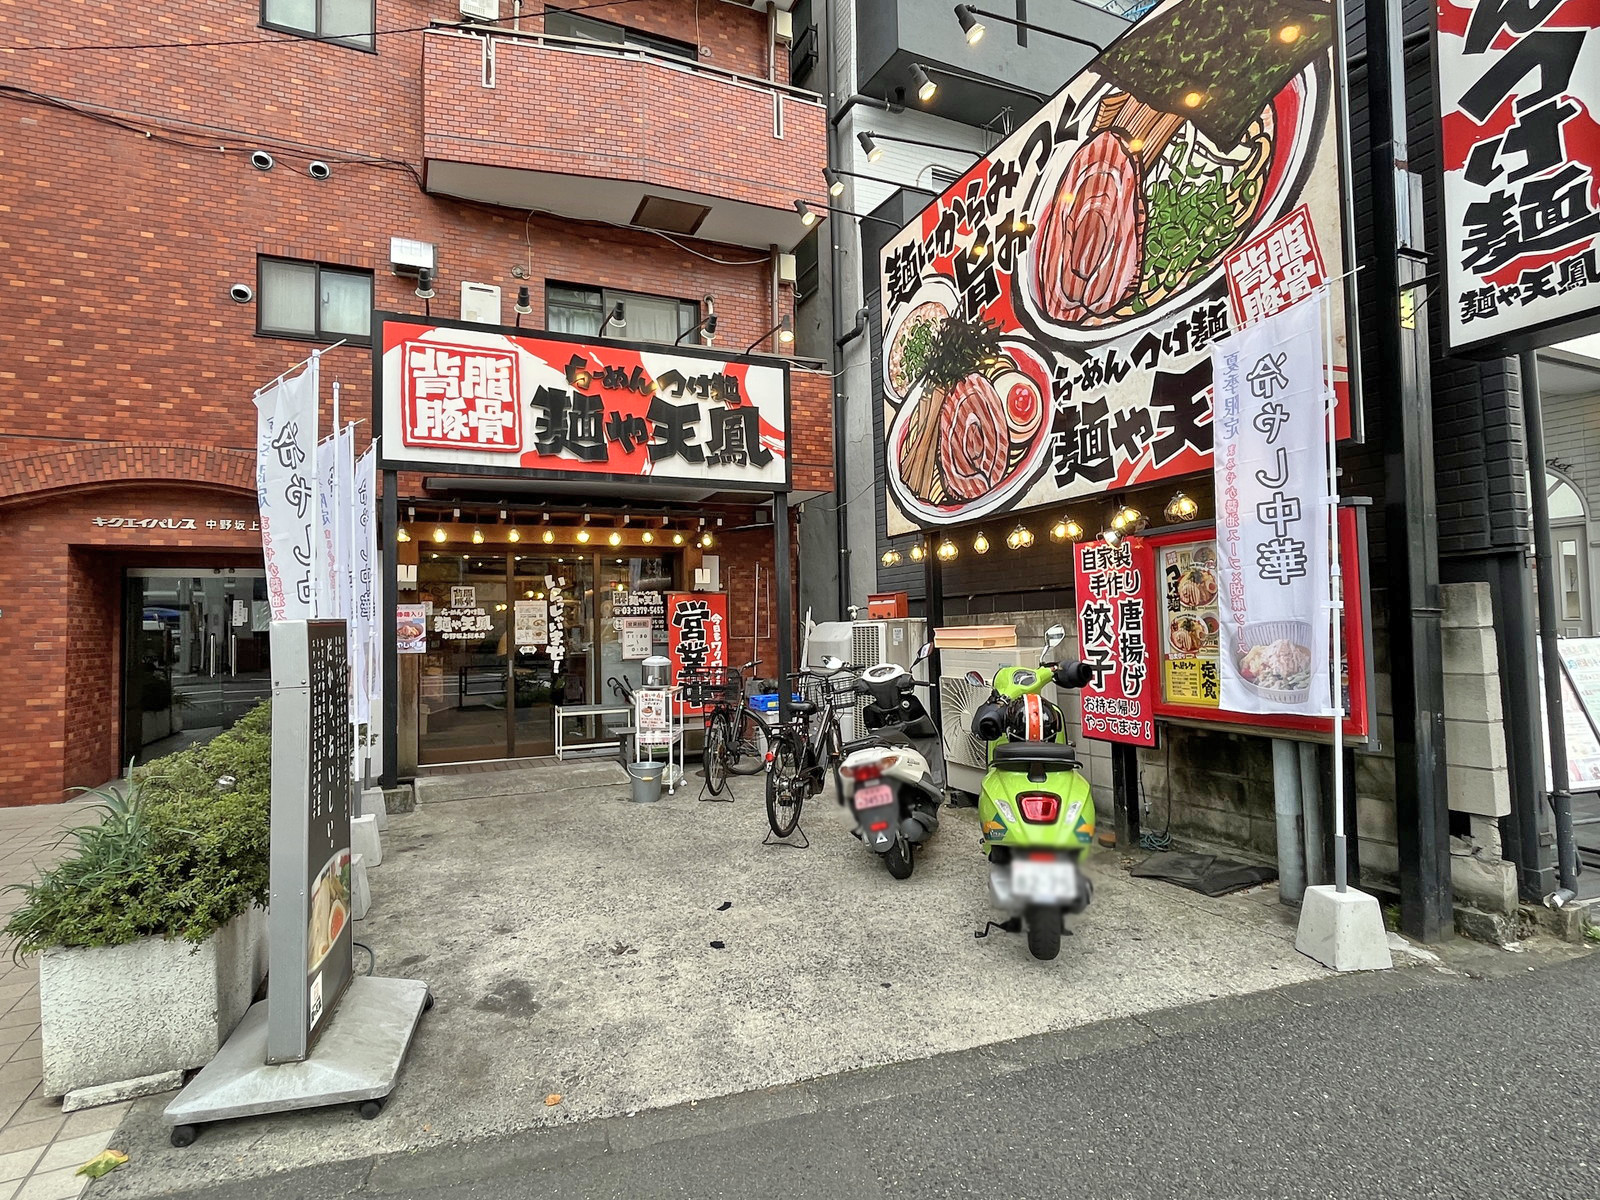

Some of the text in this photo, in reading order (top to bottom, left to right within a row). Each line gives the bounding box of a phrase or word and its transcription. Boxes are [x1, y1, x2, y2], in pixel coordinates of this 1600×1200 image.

[885, 94, 1080, 313] 麺にからみつく
[953, 210, 1037, 320] 旨み
[1231, 215, 1312, 297] 背脂
[1242, 257, 1317, 330] 豚骨
[410, 348, 510, 401] 背脂
[564, 353, 742, 403] らーめん つけ麺
[1052, 301, 1232, 402] らーめん つけ麺
[414, 398, 513, 444] 豚骨
[530, 384, 774, 469] 麺や天鳳
[92, 516, 260, 531] キクエイパレス 中野坂上
[1082, 542, 1131, 572] 自家製
[1091, 570, 1140, 598] 手作り
[1081, 602, 1116, 690] 餃子
[1119, 598, 1146, 697] 唐揚げ
[1085, 697, 1140, 717] お持ち帰り
[1201, 661, 1217, 699] 定食
